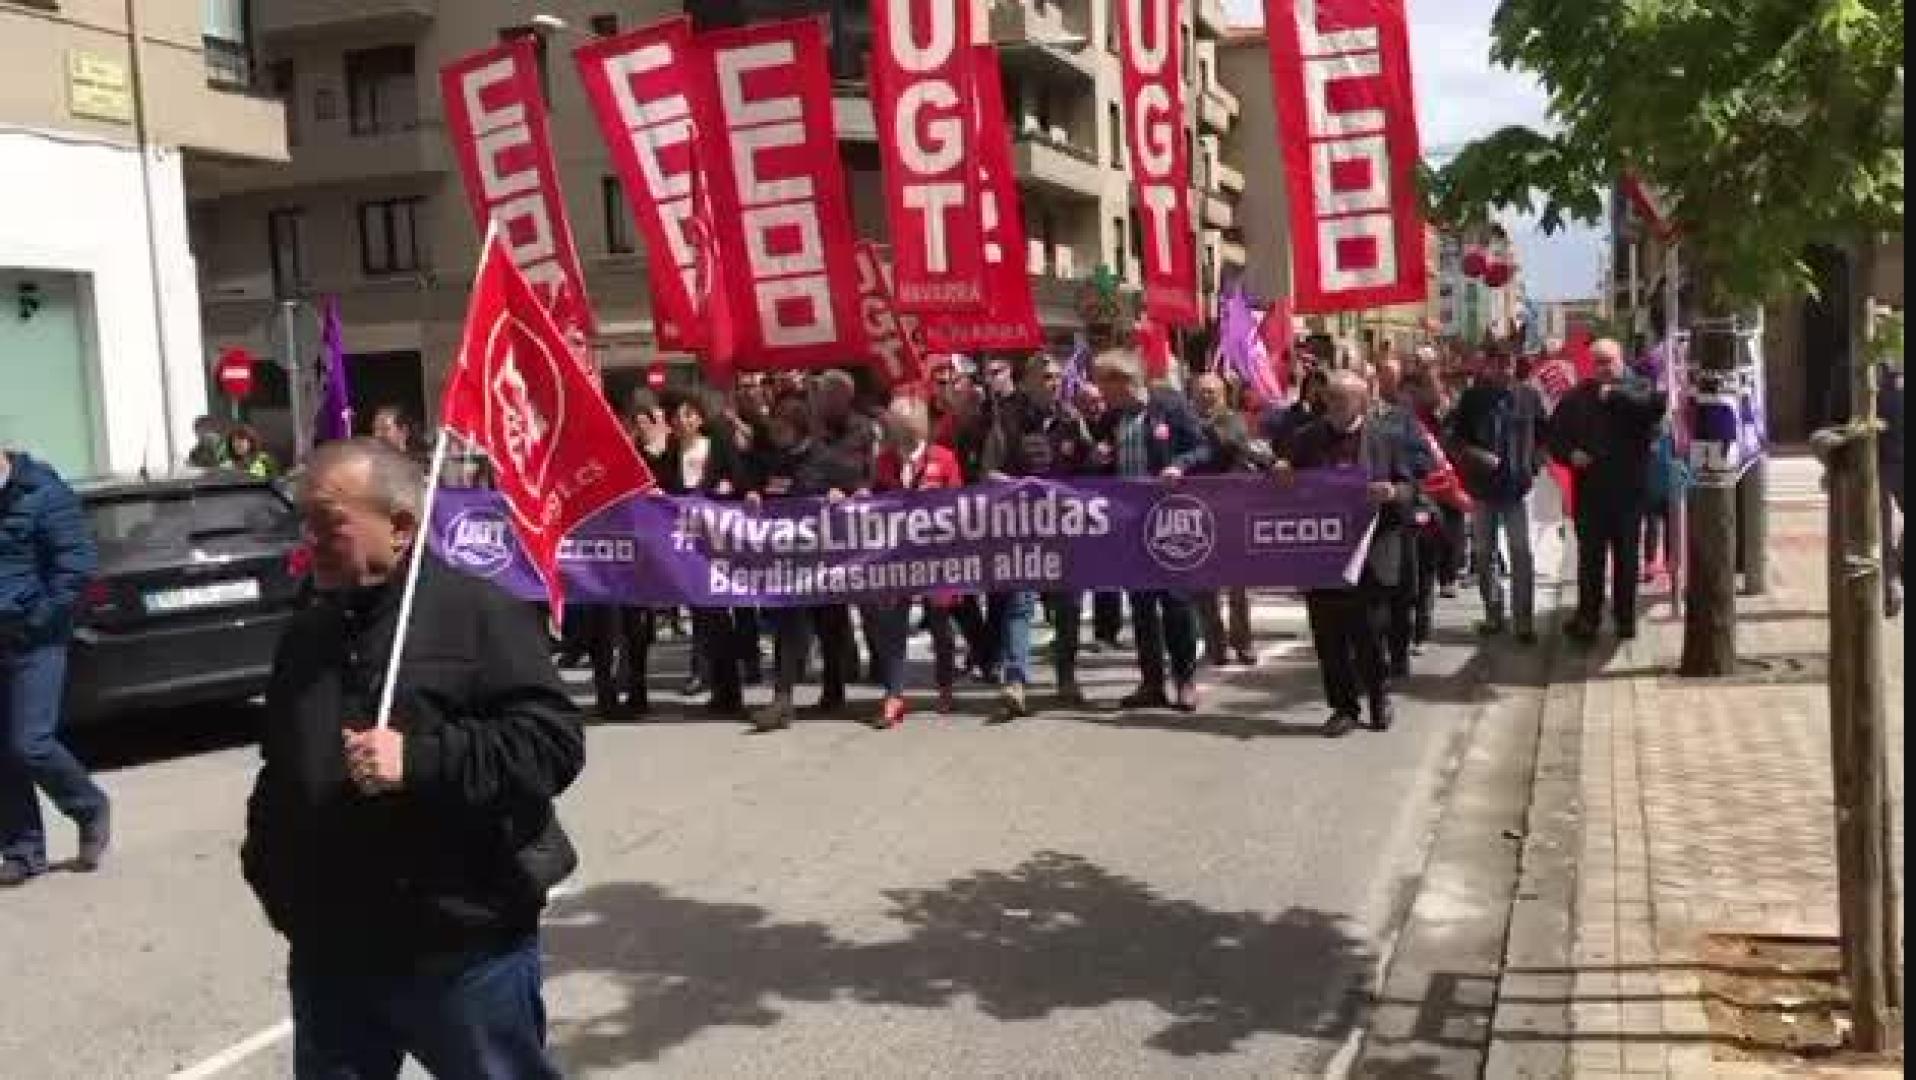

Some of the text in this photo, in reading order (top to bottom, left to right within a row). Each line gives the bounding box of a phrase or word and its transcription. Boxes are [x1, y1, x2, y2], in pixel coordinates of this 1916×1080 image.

[714, 40, 837, 347] CCOO
[889, 0, 964, 272] UGT
[1128, 0, 1176, 274] UGT
[994, 543, 1062, 581] alde
[1253, 518, 1343, 543] CCOO
